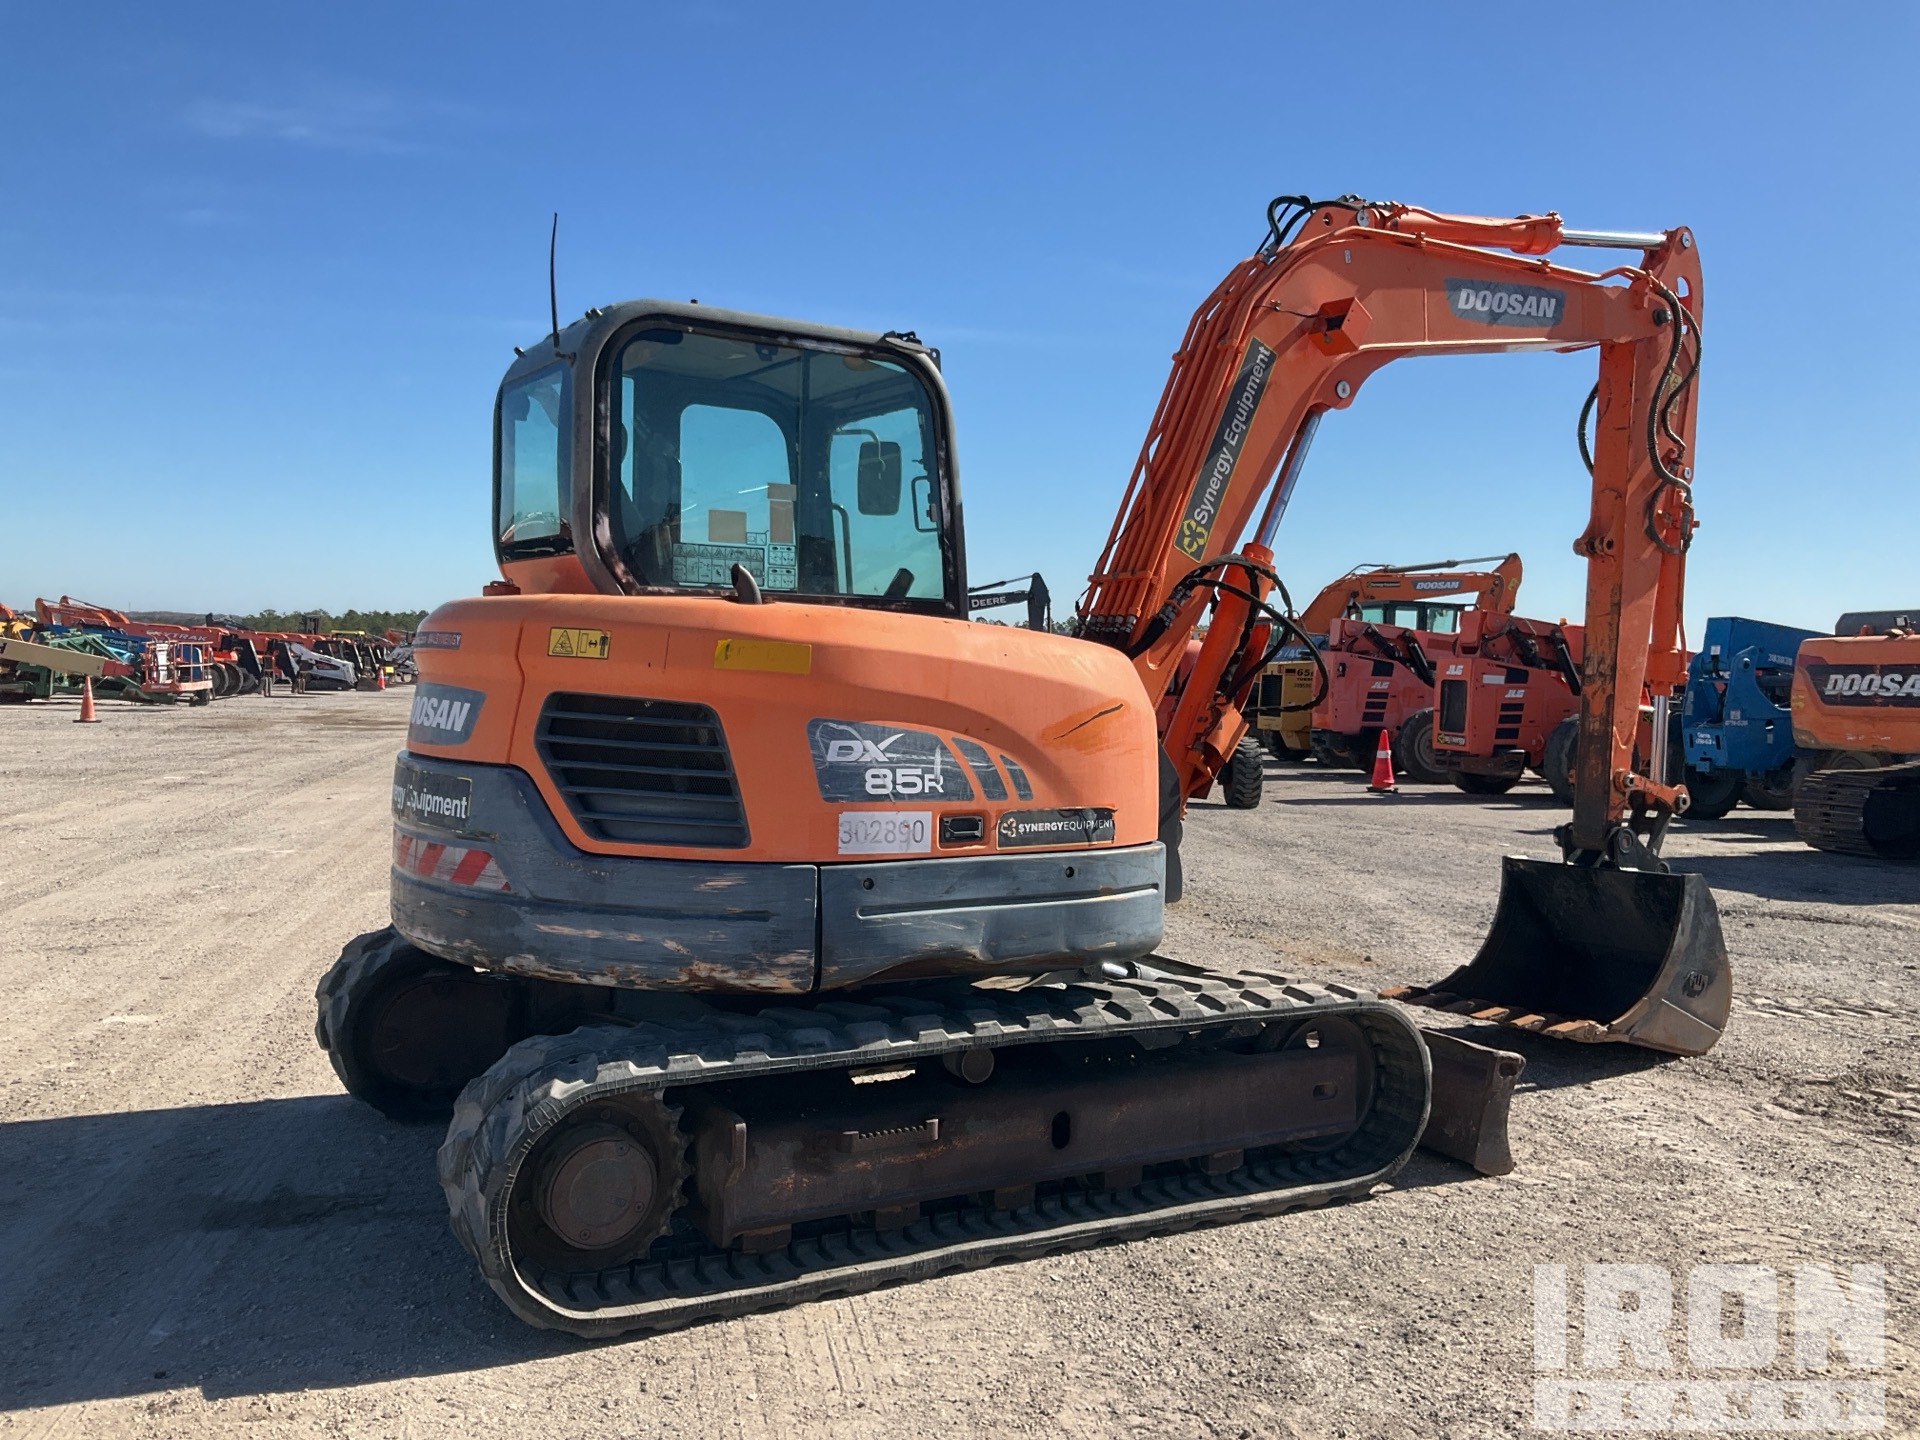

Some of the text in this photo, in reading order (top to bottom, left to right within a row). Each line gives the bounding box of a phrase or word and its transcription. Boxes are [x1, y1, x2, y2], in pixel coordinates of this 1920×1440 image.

[1457, 288, 1556, 318] DOOSAN
[1194, 345, 1271, 525] Synergy Equipment
[1416, 581, 1460, 590] DOOSAN
[971, 596, 1007, 608] DEERE
[1446, 664, 1464, 676] JLG
[1371, 681, 1390, 689] JLG
[1824, 673, 1920, 696] DOOSA
[1504, 689, 1525, 698] JLG
[826, 733, 905, 762] DX
[864, 768, 945, 795] 85R
